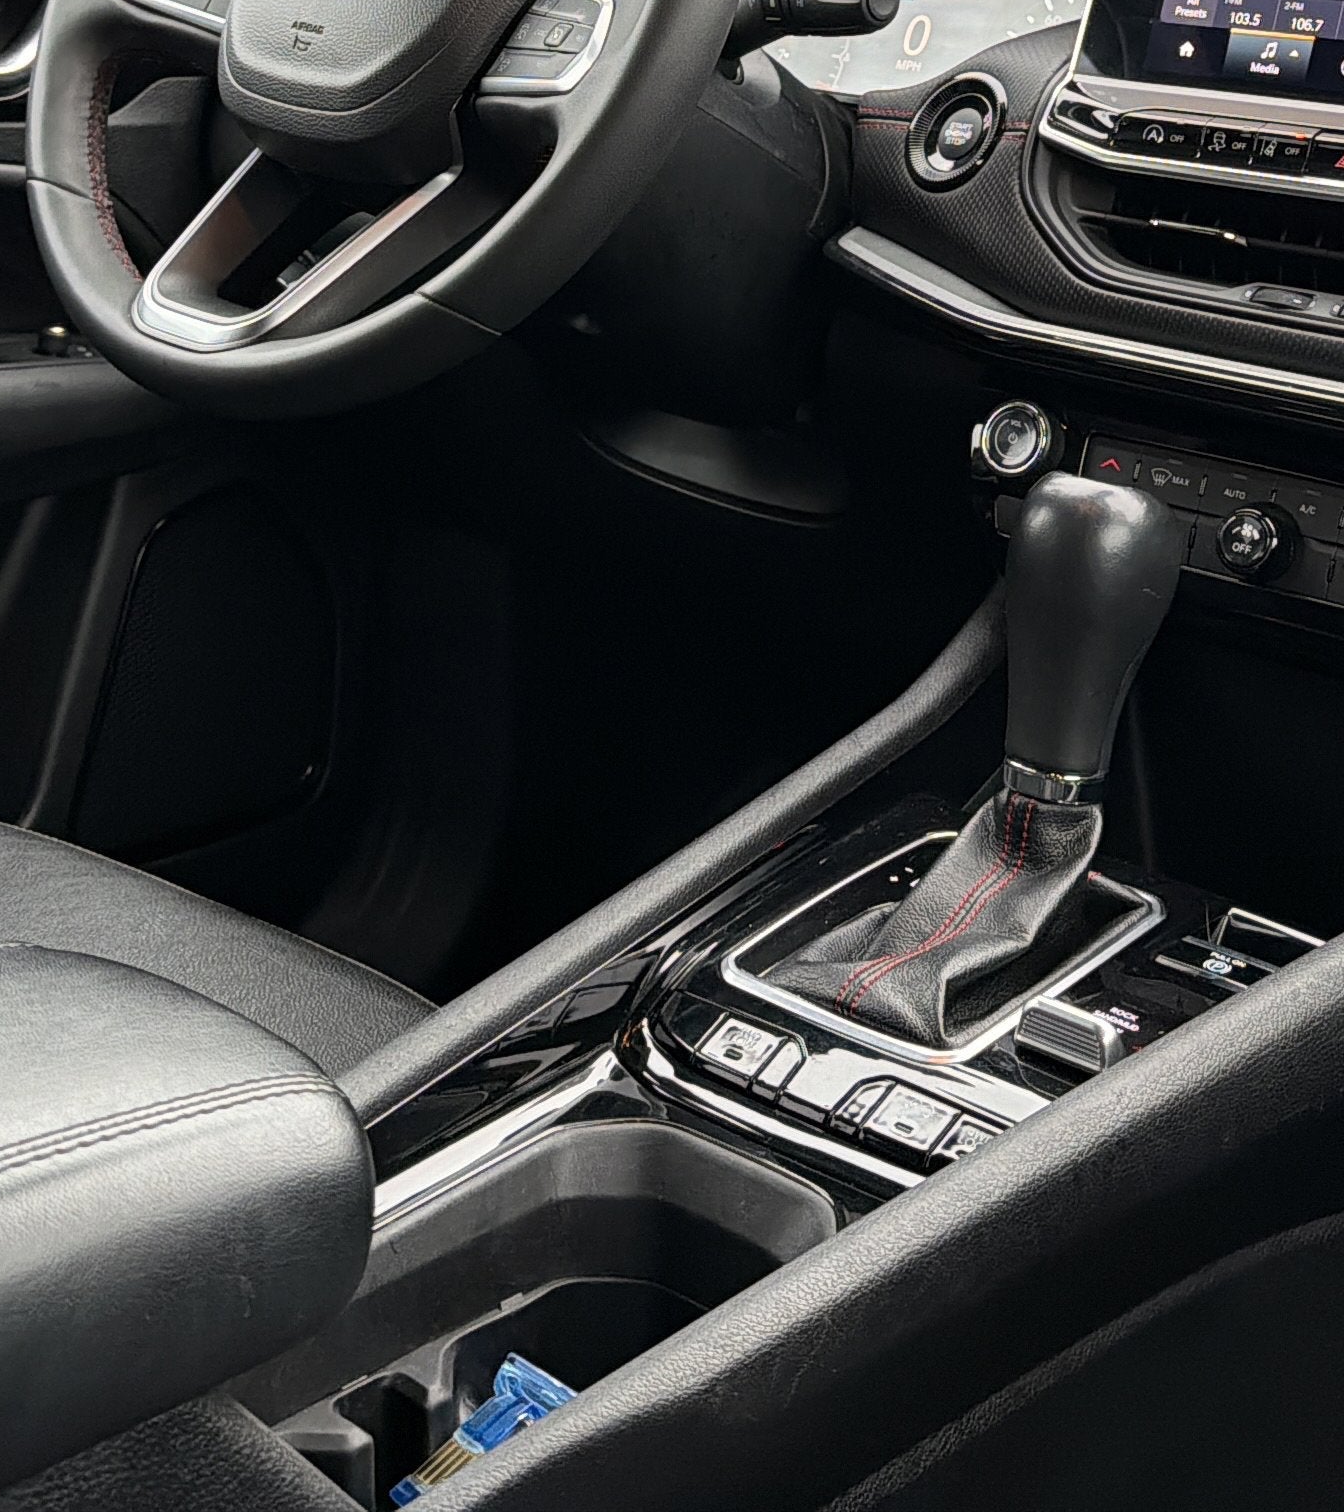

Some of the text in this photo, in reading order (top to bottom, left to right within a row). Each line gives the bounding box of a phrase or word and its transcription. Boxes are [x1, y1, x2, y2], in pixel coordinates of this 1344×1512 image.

[1174, 5, 1208, 20] Presets
[1229, 11, 1261, 26] 103.5
[290, 20, 324, 35] AIRBAG
[1290, 17, 1324, 32] 106.7
[902, 14, 932, 57] 0
[895, 58, 923, 72] MPH
[1249, 61, 1281, 76] Media
[1169, 133, 1185, 144] OFF
[1232, 141, 1248, 151] OFF
[1284, 146, 1301, 156] OFF
[1171, 475, 1191, 487] MAX
[1223, 488, 1247, 501] AUTO
[1299, 503, 1317, 516] A/C
[1232, 541, 1253, 555] OFF
[1109, 1006, 1140, 1022] ROCK
